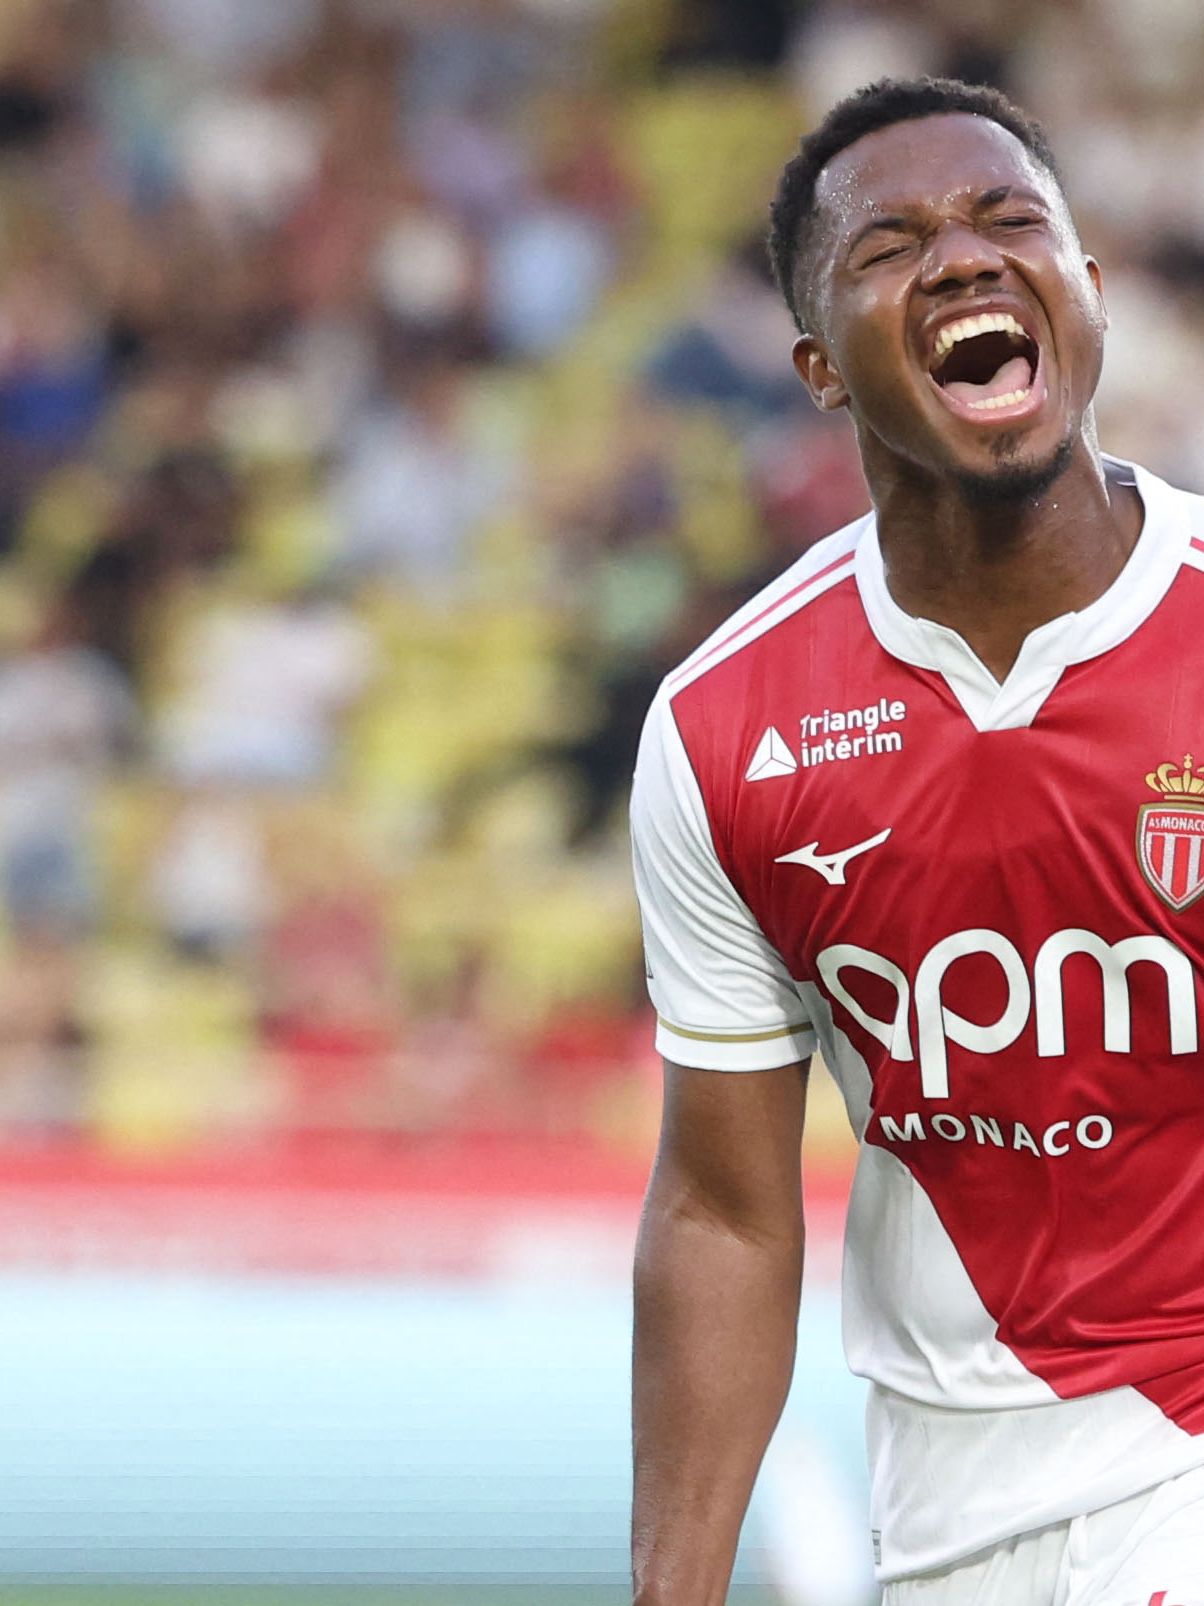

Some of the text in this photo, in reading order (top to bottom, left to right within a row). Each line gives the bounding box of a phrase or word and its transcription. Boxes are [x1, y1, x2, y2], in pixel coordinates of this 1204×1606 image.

[800, 698, 906, 739] Triangle
[801, 731, 903, 768] intérim
[815, 928, 1199, 1099] apm
[879, 1112, 1114, 1158] MONACO
